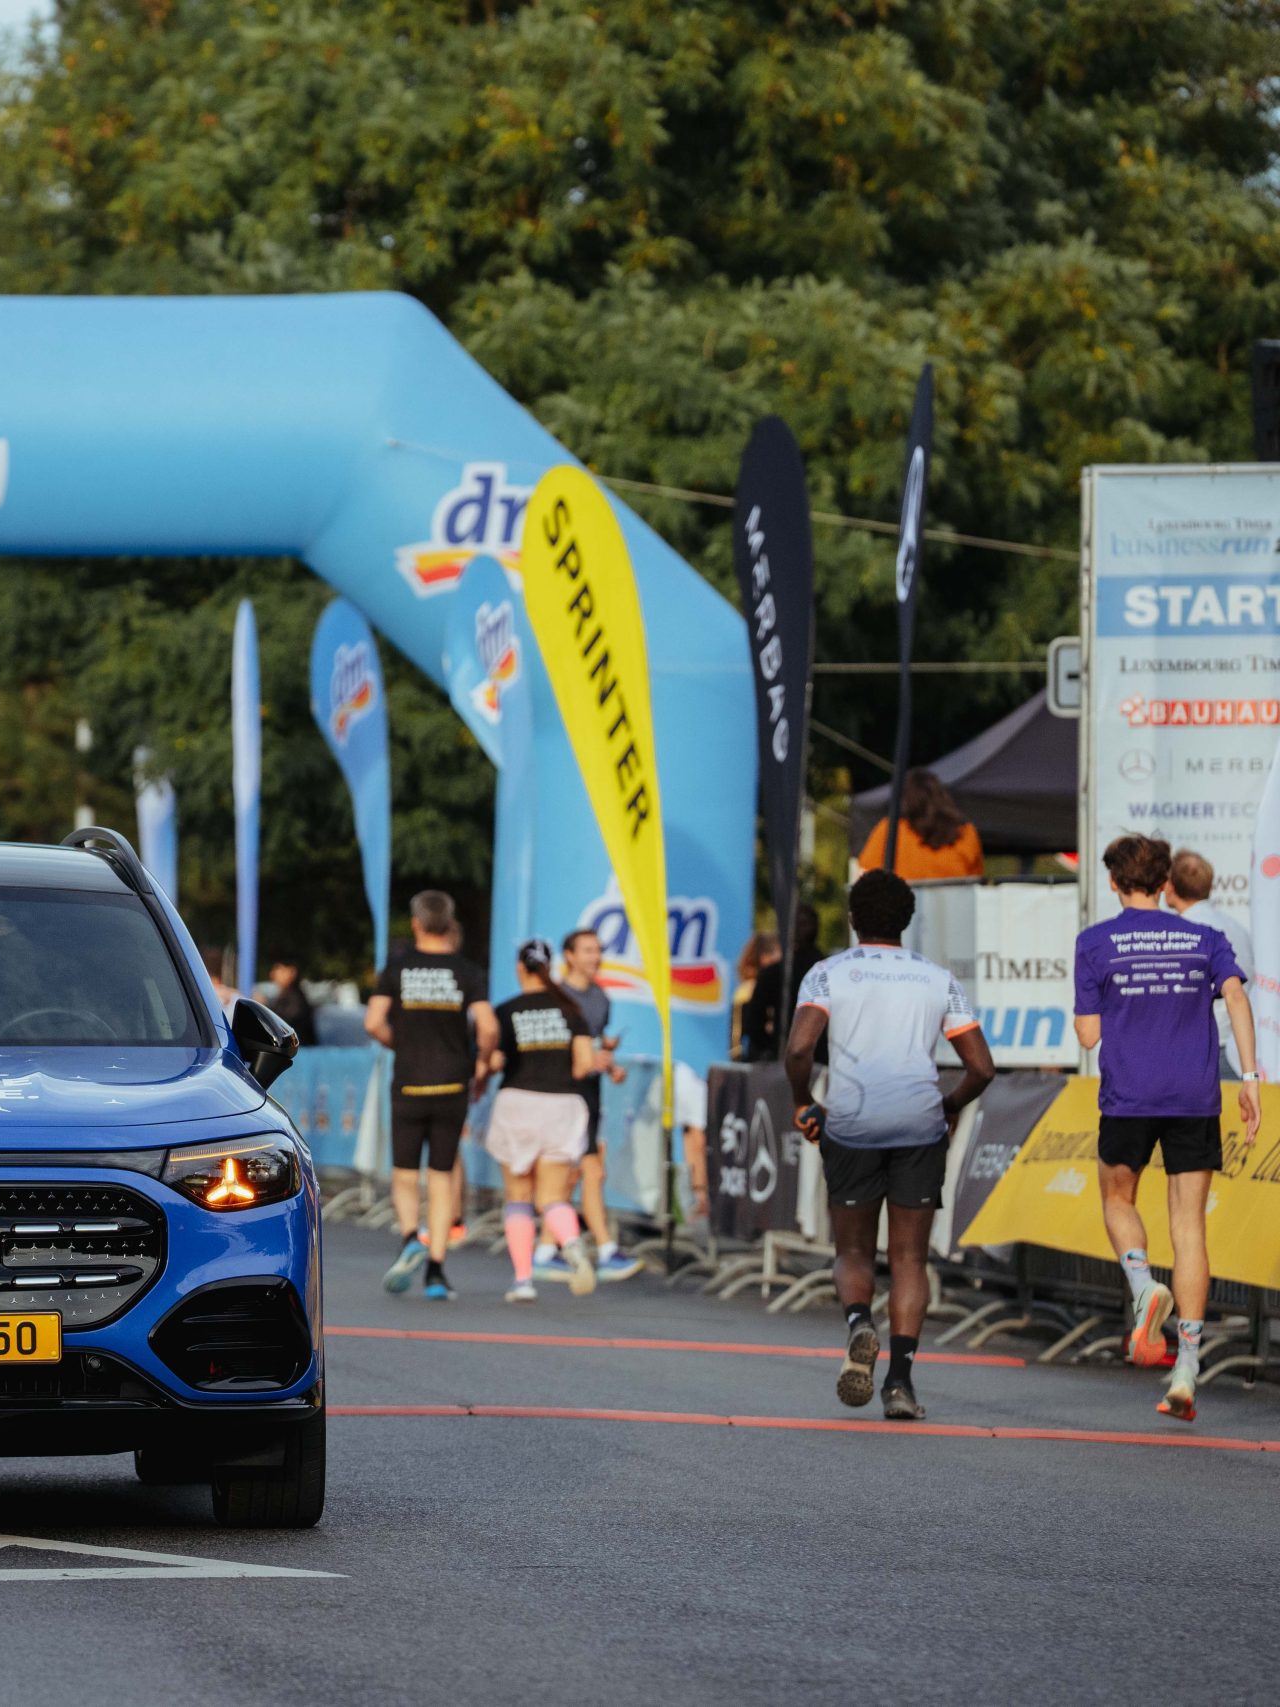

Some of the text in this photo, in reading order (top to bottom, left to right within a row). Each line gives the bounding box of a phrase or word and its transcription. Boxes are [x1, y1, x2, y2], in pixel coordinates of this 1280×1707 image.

[542, 497, 652, 840] SPRINTER
[1119, 656, 1241, 674] LUXEMBOURG
[1149, 699, 1280, 726] BAUHAU
[1185, 757, 1273, 774] MERB
[1128, 802, 1258, 819] WAGNERTEC
[1132, 930, 1167, 941] trusted
[1167, 931, 1202, 943] partner
[977, 952, 1068, 982] TIMES
[978, 1006, 1066, 1047] un
